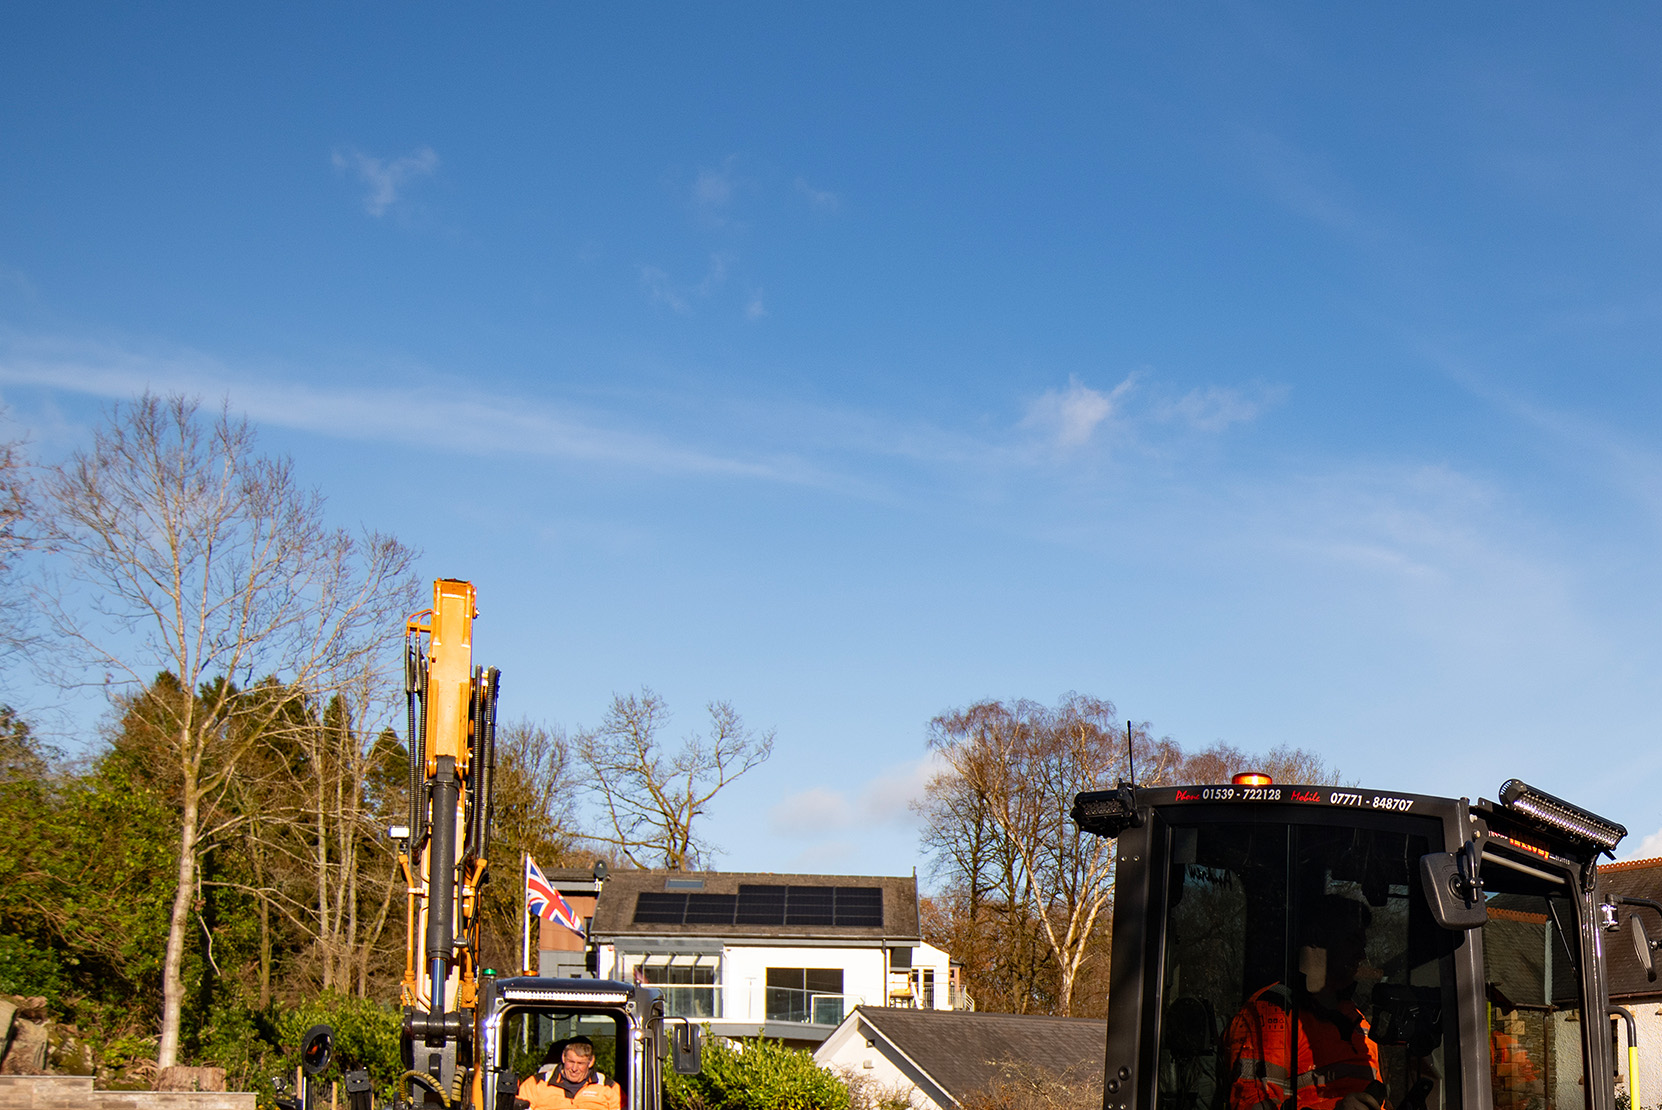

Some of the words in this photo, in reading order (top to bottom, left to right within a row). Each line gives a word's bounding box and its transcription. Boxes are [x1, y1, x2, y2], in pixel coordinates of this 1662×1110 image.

[1175, 790, 1200, 801] Phone
[1202, 789, 1234, 801] 01539
[1243, 789, 1282, 801] 722128
[1290, 790, 1321, 803] Mobile
[1330, 792, 1363, 807] 07771
[1372, 797, 1414, 812] 848707
